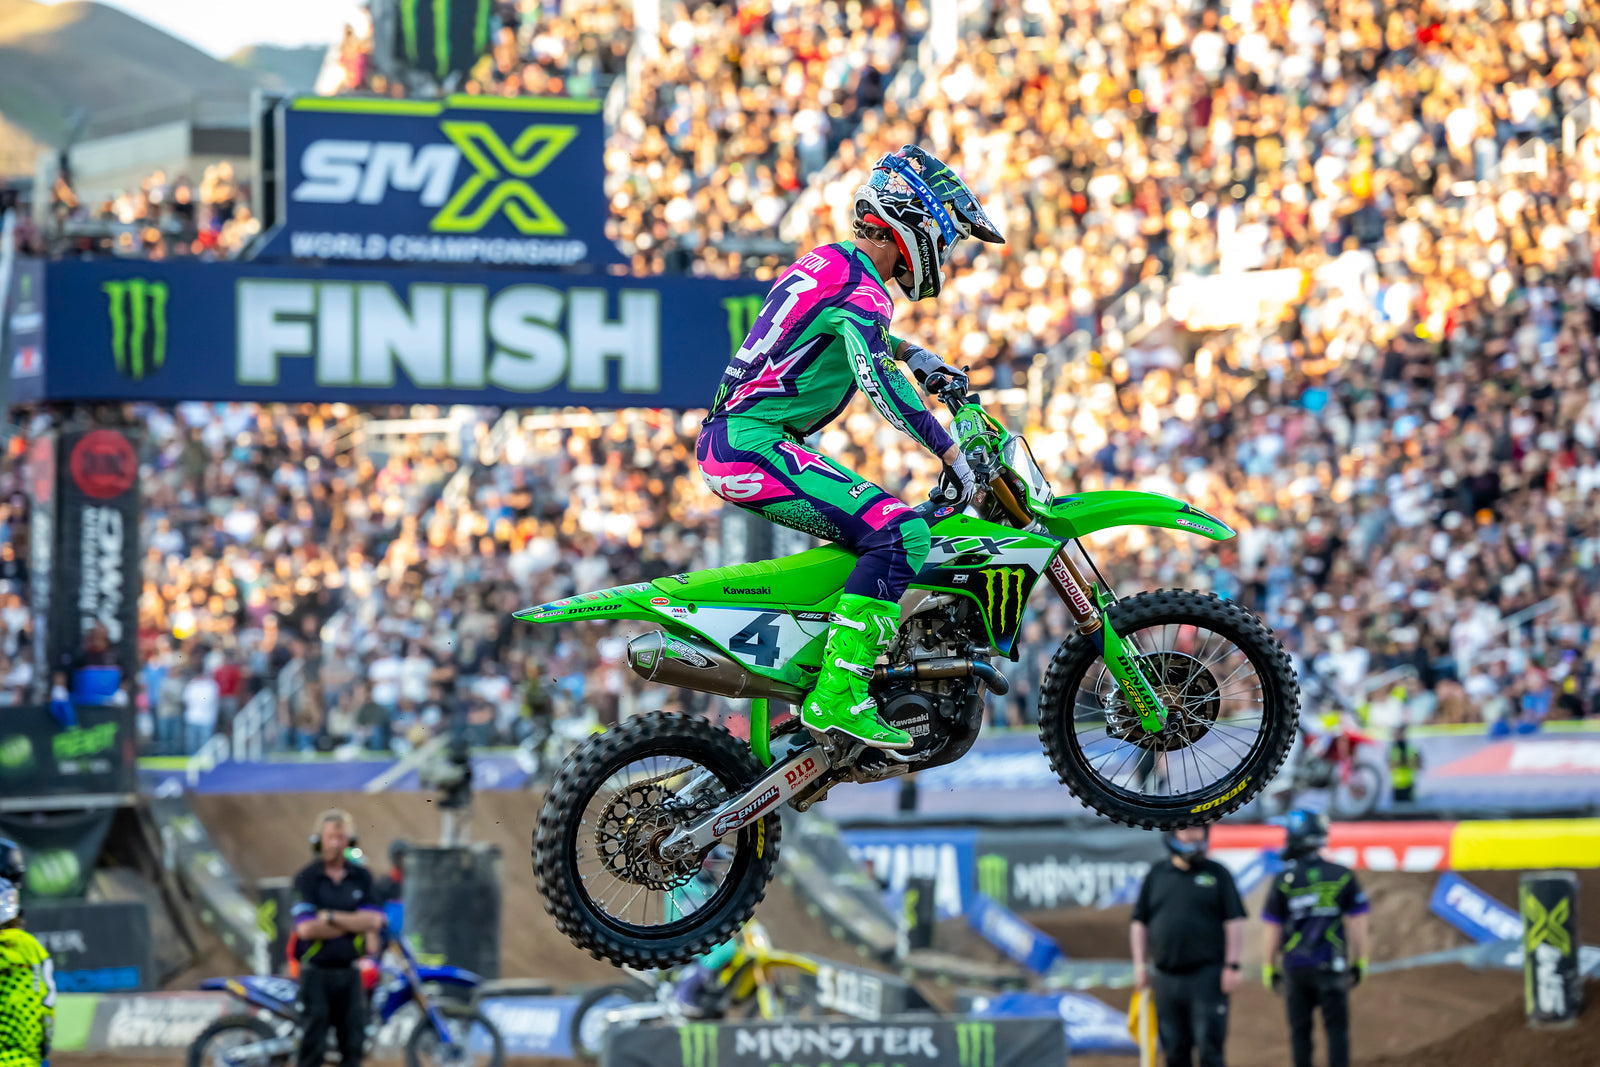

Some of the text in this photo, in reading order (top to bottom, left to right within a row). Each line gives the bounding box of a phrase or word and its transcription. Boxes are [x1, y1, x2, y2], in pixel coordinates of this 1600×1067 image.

[292, 121, 579, 234] SMX
[918, 184, 953, 235] OAKLEY
[291, 231, 587, 265] WORLD CHAMPIONSHIP
[235, 277, 661, 393] FINISH
[1056, 499, 1085, 512] SEXTON
[930, 536, 1028, 556] KX
[568, 603, 622, 615] DUNLOP
[723, 586, 771, 595] Kawasaki
[1057, 569, 1091, 614] SHOWA
[729, 612, 780, 667] 4
[1116, 654, 1160, 714] DUNLOP
[890, 712, 929, 727] Kawasaki
[1190, 779, 1248, 814] DUNLOP
[735, 1022, 939, 1061] MONSTER
